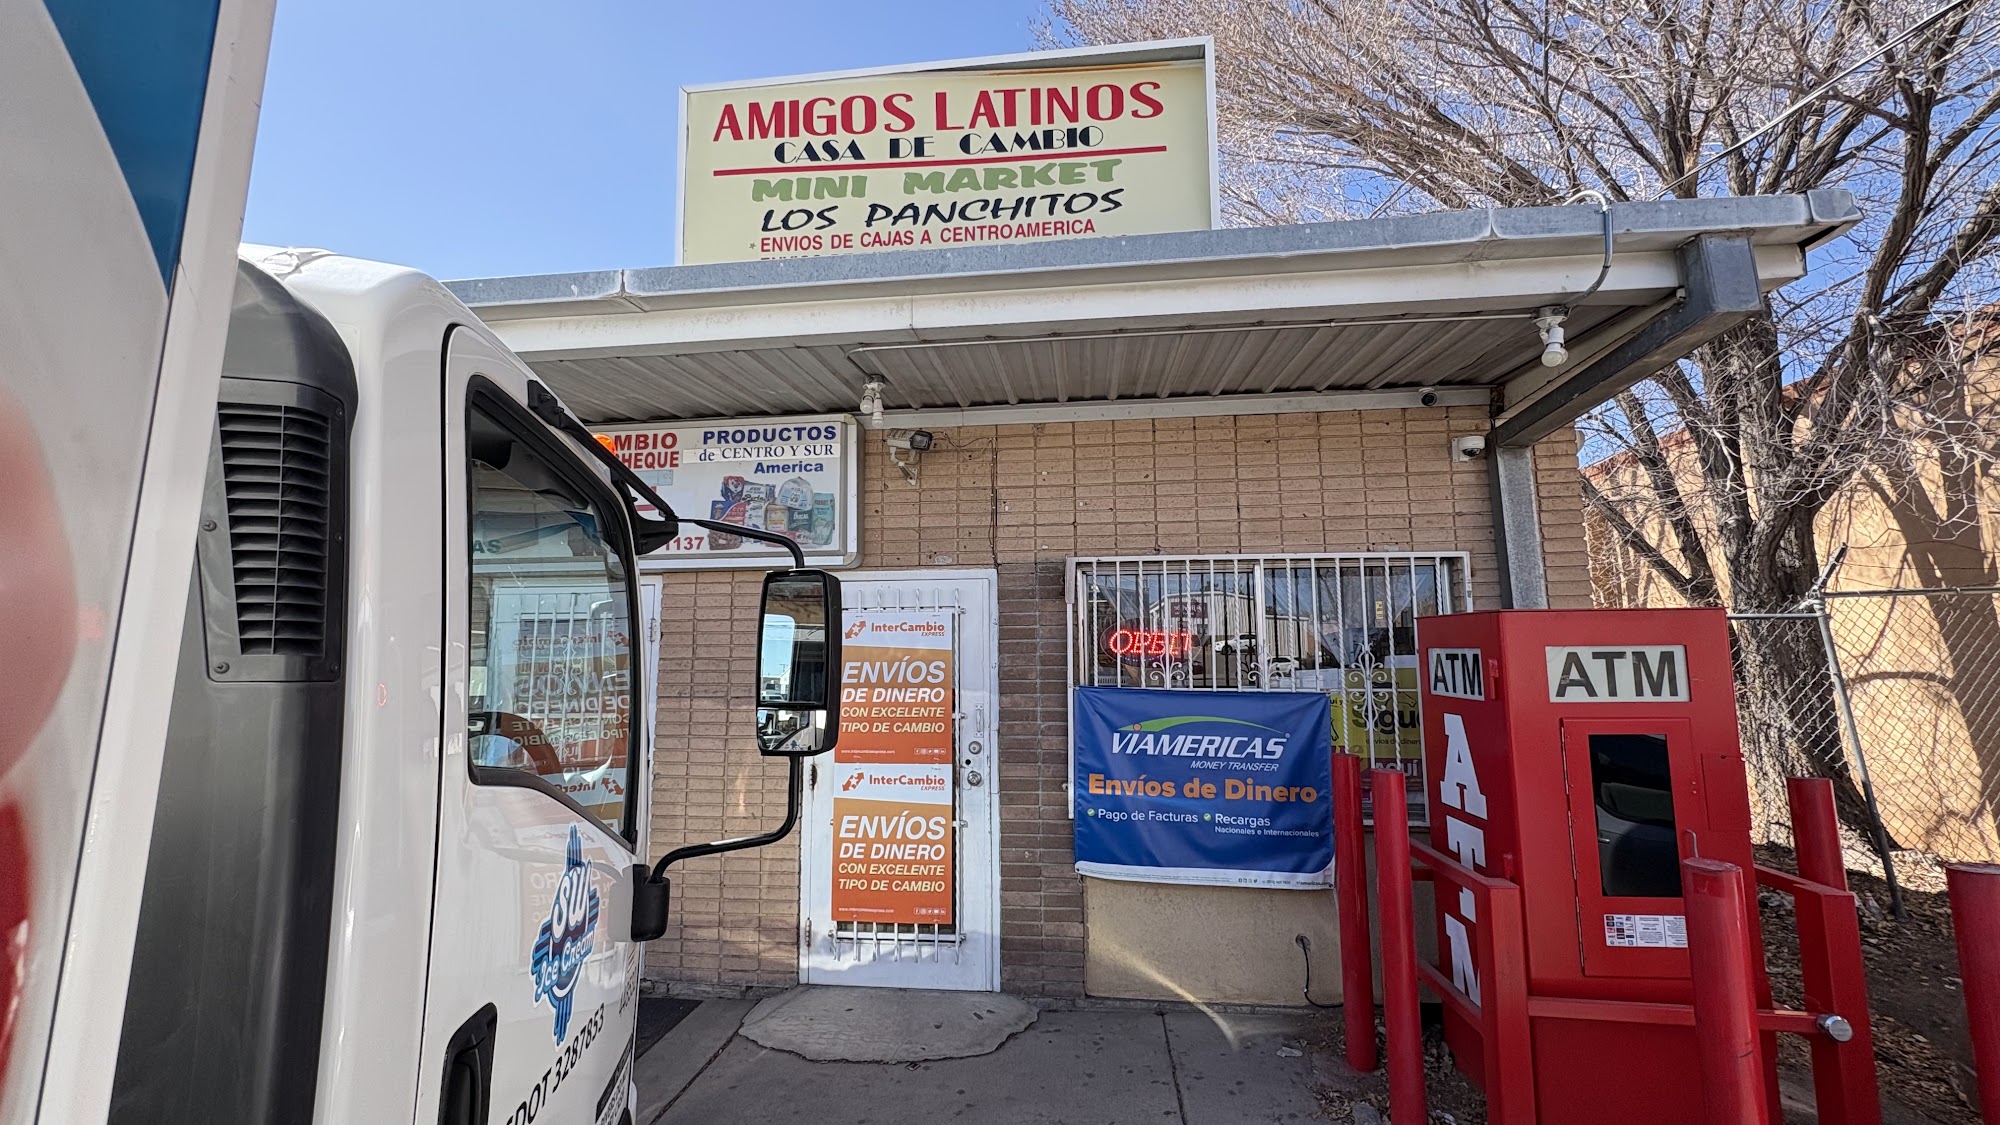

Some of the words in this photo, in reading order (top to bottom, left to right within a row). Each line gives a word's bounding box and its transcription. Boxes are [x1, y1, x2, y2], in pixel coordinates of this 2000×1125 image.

[713, 93, 915, 142] AMIGOS
[936, 82, 1164, 131] LATINOS
[774, 139, 866, 164] CASA
[889, 136, 935, 159] DE
[959, 125, 1104, 155] CAMBIO
[752, 175, 868, 202] MINI
[904, 159, 1122, 195] MARKET
[761, 205, 839, 232] LOS
[865, 188, 1124, 227] PANCHITOS
[761, 235, 823, 252] ENVIOS
[831, 233, 853, 249] DE
[860, 230, 914, 247] CAJAS
[920, 230, 932, 244] A
[940, 219, 1096, 243] CENTROAMERICA
[703, 426, 836, 445] PRODUCTOS
[616, 451, 679, 469] HEQUE
[699, 448, 715, 461] de
[721, 445, 785, 459] CENTRO
[790, 446, 799, 456] Y
[804, 444, 835, 456] SUR
[754, 461, 824, 474] America
[871, 622, 945, 632] InterCambio
[842, 656, 946, 684] ENVÍOS
[1433, 652, 1482, 697] ATM
[1555, 651, 1679, 698] ATM
[842, 688, 869, 703] DE
[872, 687, 945, 703] DINERO
[841, 707, 869, 718] CON
[871, 707, 945, 718] EXCELENTE
[841, 722, 869, 733] TIPO
[872, 722, 890, 733] DE
[893, 722, 945, 733] CAMBIO
[1112, 733, 1287, 759] VIAMERICAS
[1190, 760, 1227, 770] MONEY
[1228, 761, 1279, 772] TRANSFER
[869, 775, 945, 785] InterCambio
[1089, 773, 1176, 798] Envíos
[1183, 778, 1217, 799] de
[1225, 778, 1317, 803] Dinero
[1098, 808, 1128, 822] Pago
[1131, 809, 1145, 820] de
[1149, 811, 1199, 823] Facturas
[1215, 813, 1271, 828] Recargas
[839, 810, 946, 840] ENVÍOS
[1215, 826, 1255, 835] Nacionales
[1264, 828, 1319, 838] Internacionales
[839, 843, 866, 859] DE
[870, 843, 945, 860] DINERO
[838, 863, 866, 875] CON
[869, 864, 945, 876] EXCELENTE
[839, 879, 867, 891] TIPO
[871, 880, 888, 891] DE
[892, 881, 945, 893] CAMBIO
[552, 861, 592, 940] SW
[561, 929, 595, 972] Cream
[552, 1002, 605, 1094] 3287853
